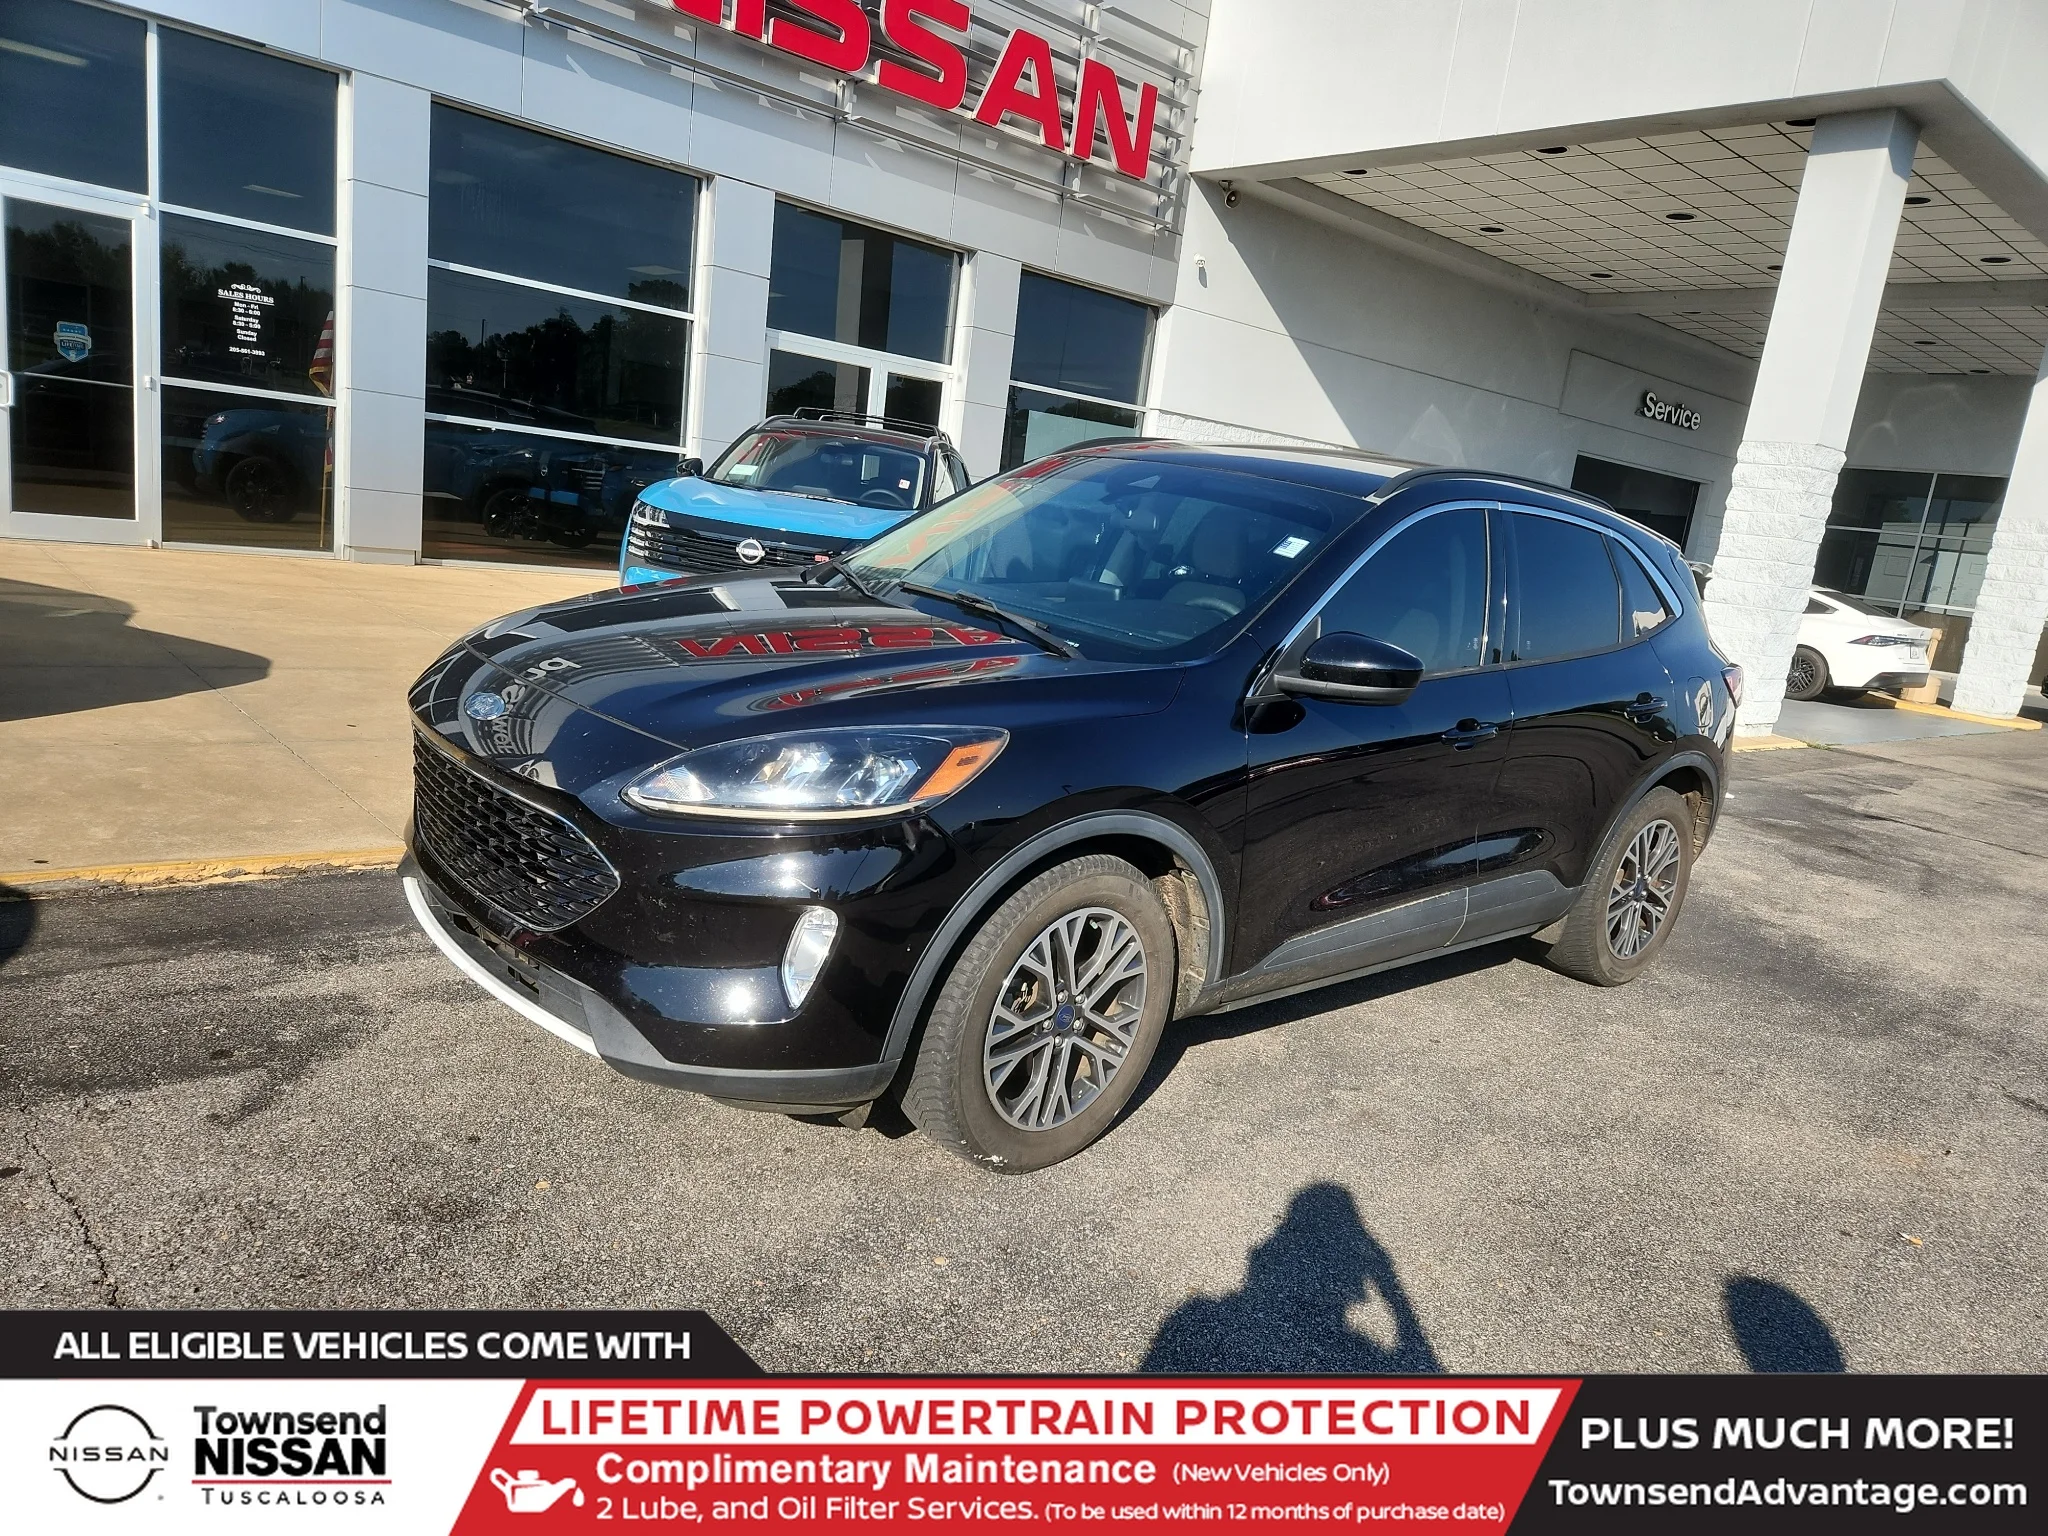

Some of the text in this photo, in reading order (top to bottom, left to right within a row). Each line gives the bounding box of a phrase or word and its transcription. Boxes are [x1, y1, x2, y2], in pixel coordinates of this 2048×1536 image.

[666, 0, 1159, 180] SSAN
[218, 289, 274, 303] SALES HOURS
[234, 314, 259, 323] Saturday
[236, 328, 257, 336] Sunday
[1643, 391, 1701, 430] Service
